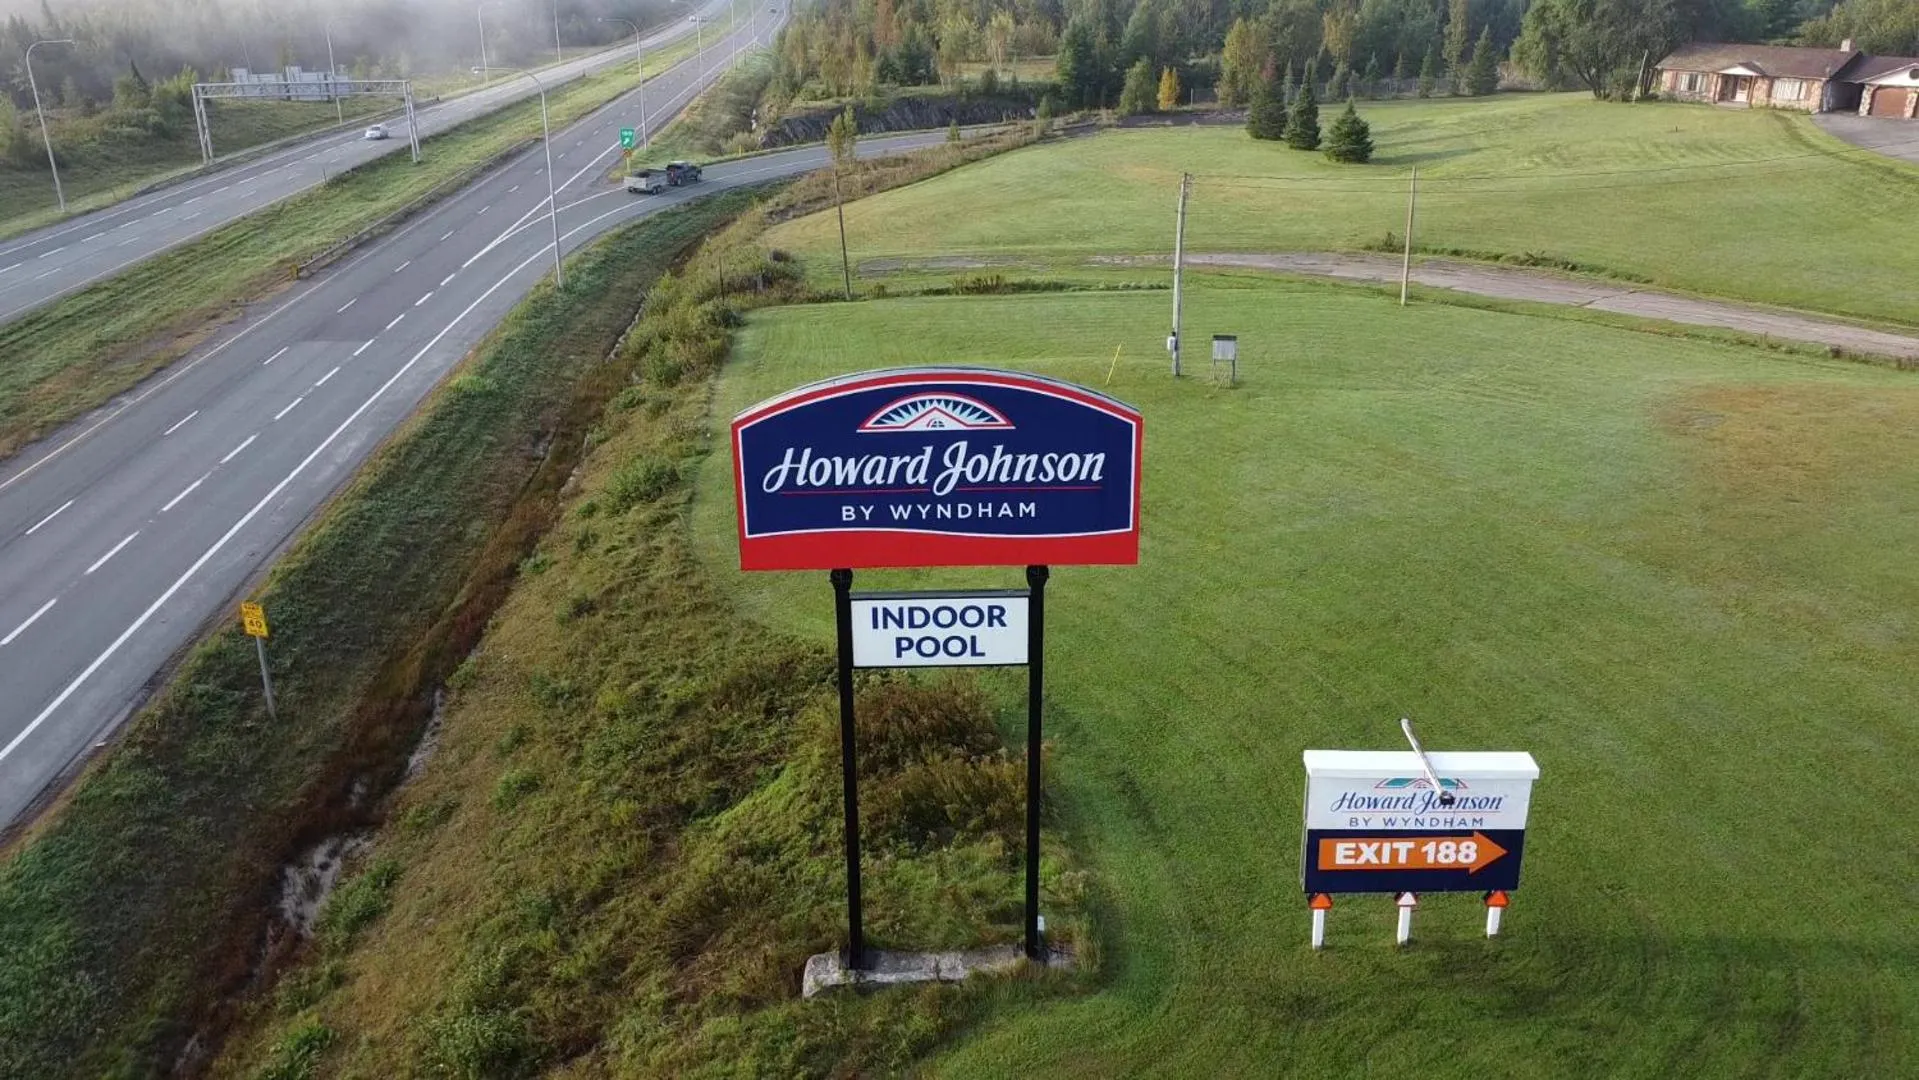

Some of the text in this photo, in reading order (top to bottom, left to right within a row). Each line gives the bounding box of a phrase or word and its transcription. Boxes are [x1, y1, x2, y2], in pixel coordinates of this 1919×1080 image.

[763, 441, 1105, 495] Howard Johnson
[841, 502, 1037, 521] BY WYNDHAM
[871, 605, 1007, 630] INDOOR
[895, 635, 986, 658] POOL
[1331, 790, 1503, 815] Howard Jonson
[1349, 817, 1484, 827] BY WYNDHAM
[1335, 841, 1478, 865] EXIT 188
